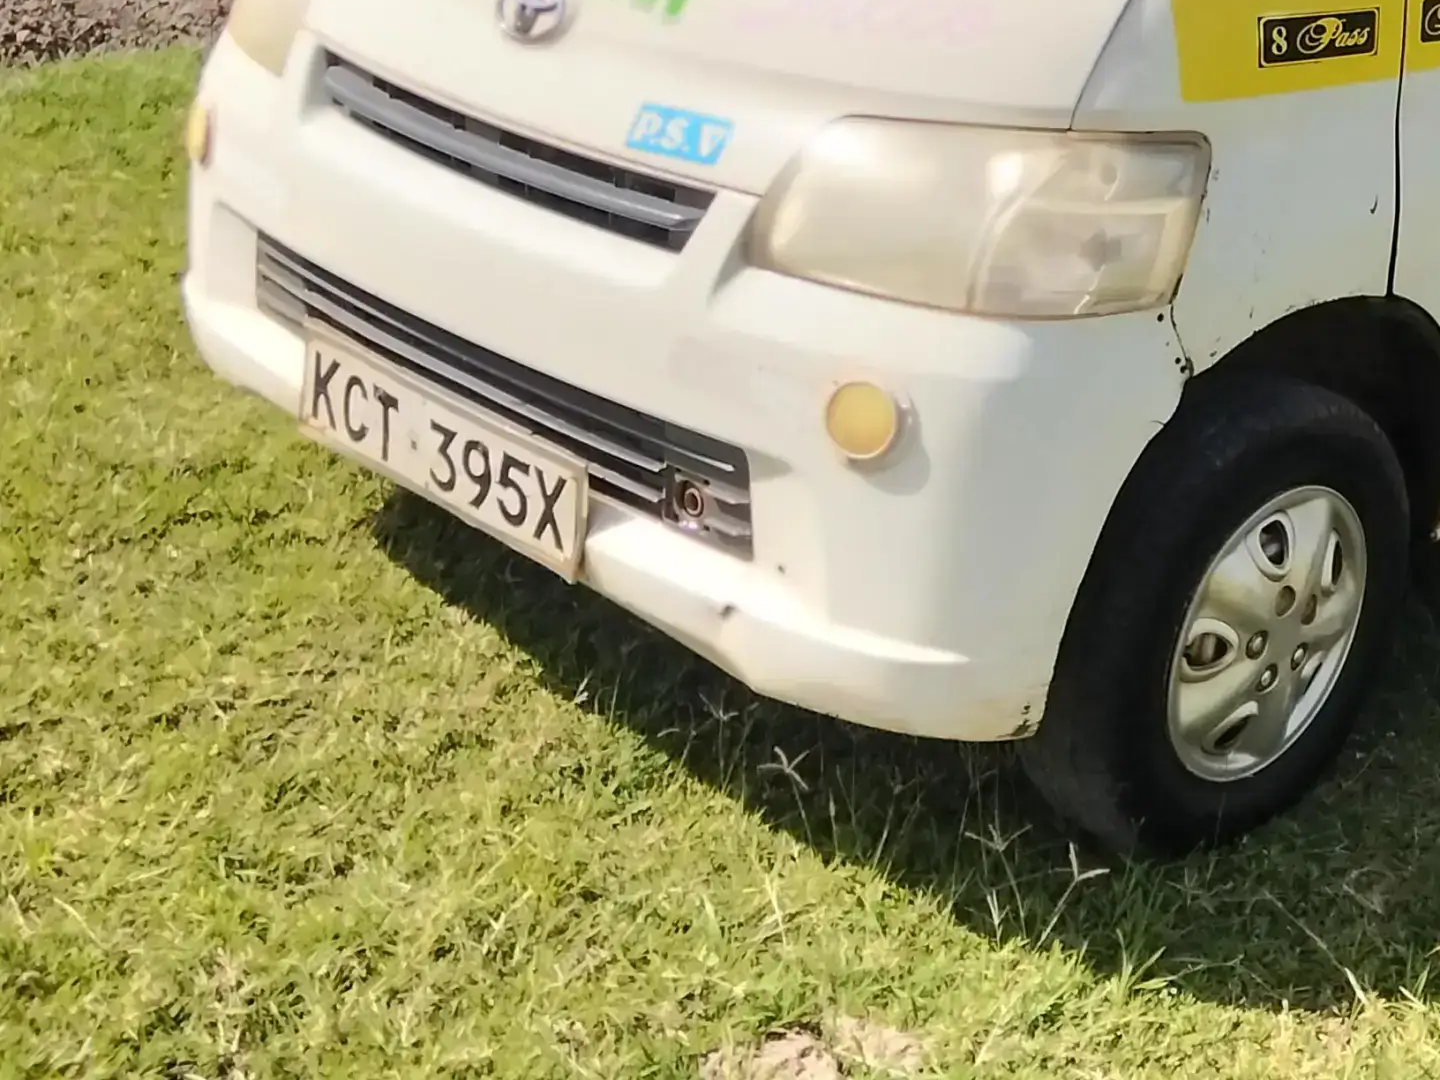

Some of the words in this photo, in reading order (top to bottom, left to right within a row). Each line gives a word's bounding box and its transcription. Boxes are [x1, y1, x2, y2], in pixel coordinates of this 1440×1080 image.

[1271, 25, 1288, 56] 8
[1296, 16, 1371, 55] Pass
[311, 349, 400, 463] KCT
[429, 418, 568, 553] 395X
